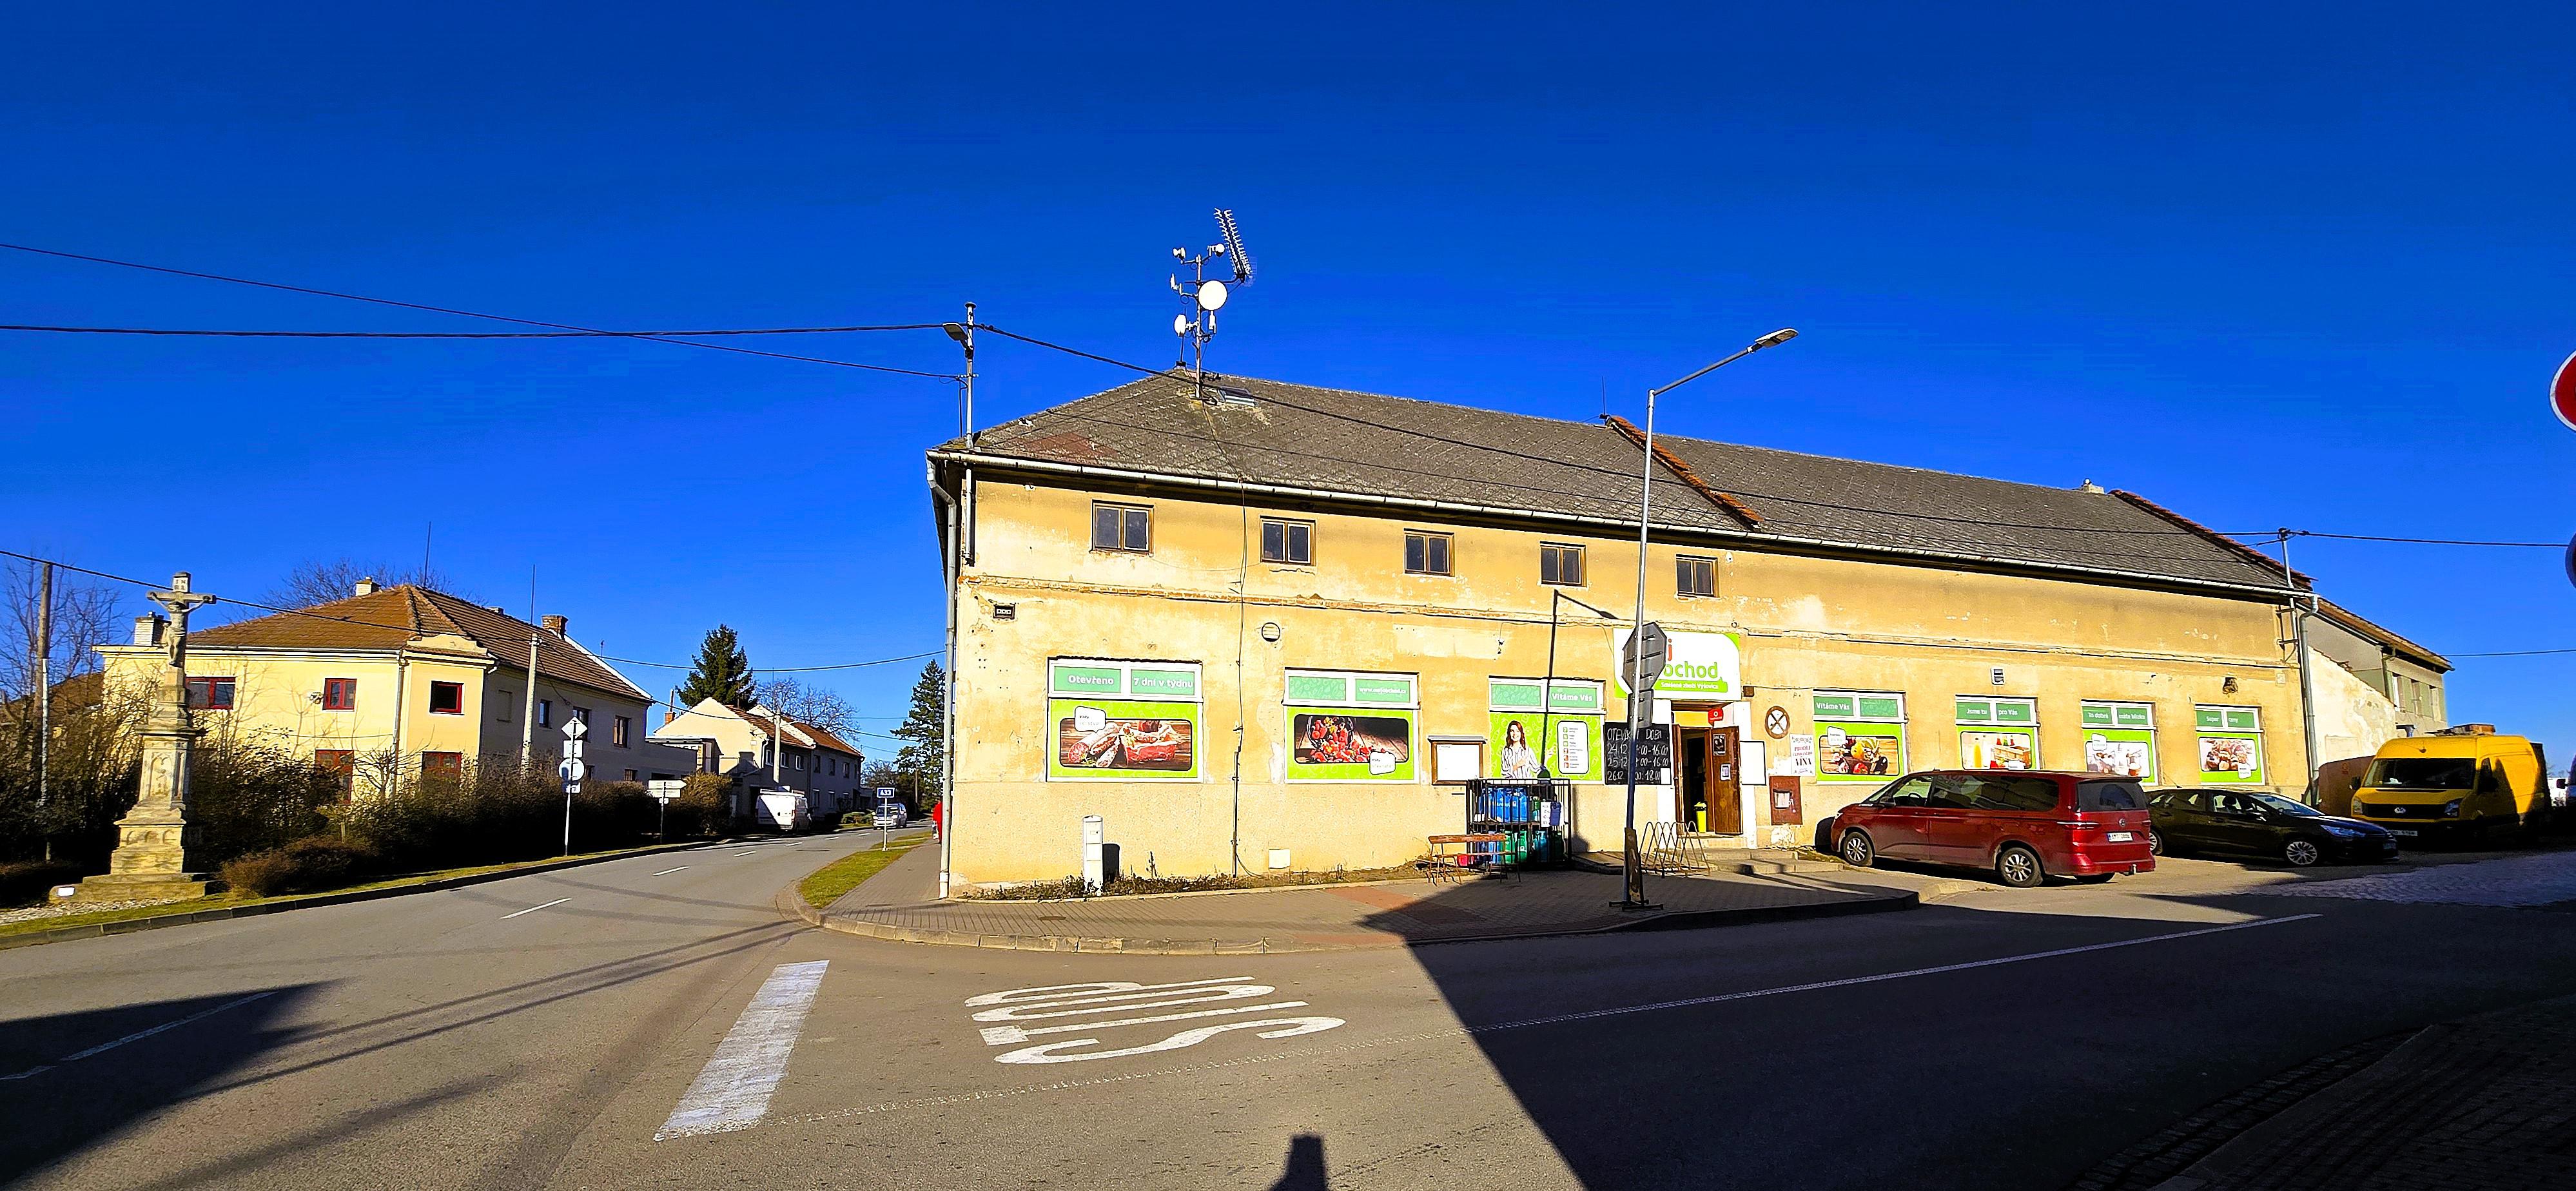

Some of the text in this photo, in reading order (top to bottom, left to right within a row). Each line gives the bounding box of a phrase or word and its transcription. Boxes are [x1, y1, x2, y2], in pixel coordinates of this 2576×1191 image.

[1068, 675, 1115, 685] Otevřeno
[1133, 677, 1140, 686] 7
[1141, 678, 1156, 686] dní
[1166, 679, 1193, 689] týdnu
[1551, 693, 1579, 701] Vítáme
[1645, 728, 1663, 741] DOBA
[964, 976, 1347, 1065] STOP
